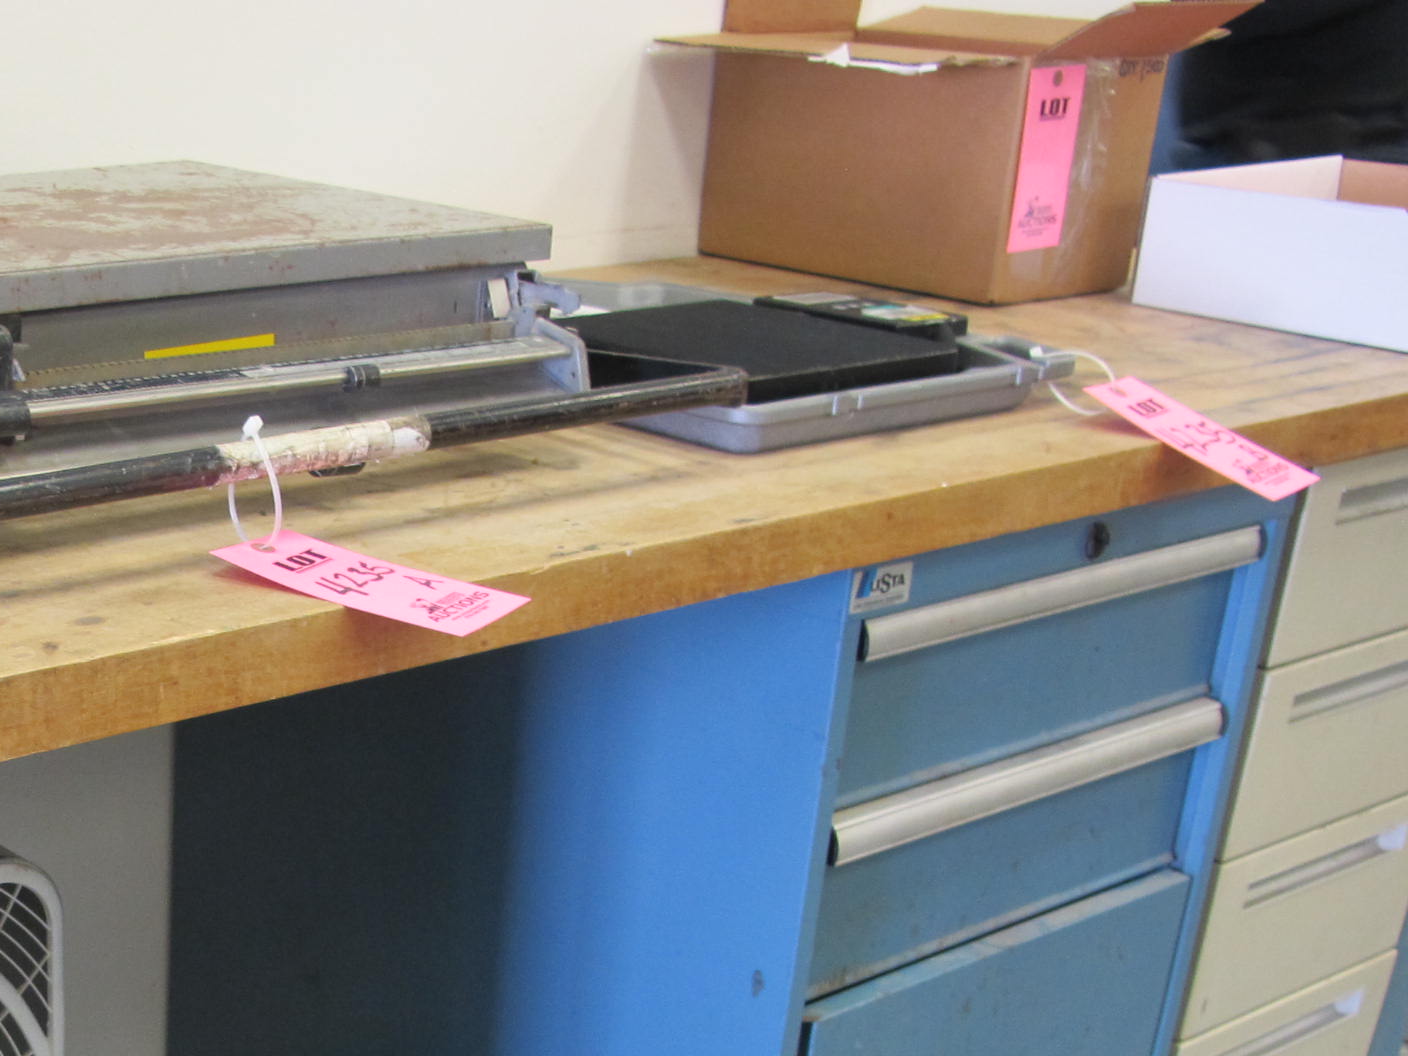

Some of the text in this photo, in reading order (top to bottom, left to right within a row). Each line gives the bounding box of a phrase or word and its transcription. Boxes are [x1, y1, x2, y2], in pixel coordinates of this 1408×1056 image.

[1039, 97, 1070, 117] LOT
[1128, 398, 1165, 417] LOT
[272, 549, 328, 572] LOT
[314, 561, 395, 596] 4235
[428, 590, 490, 623] AUCTIONS
